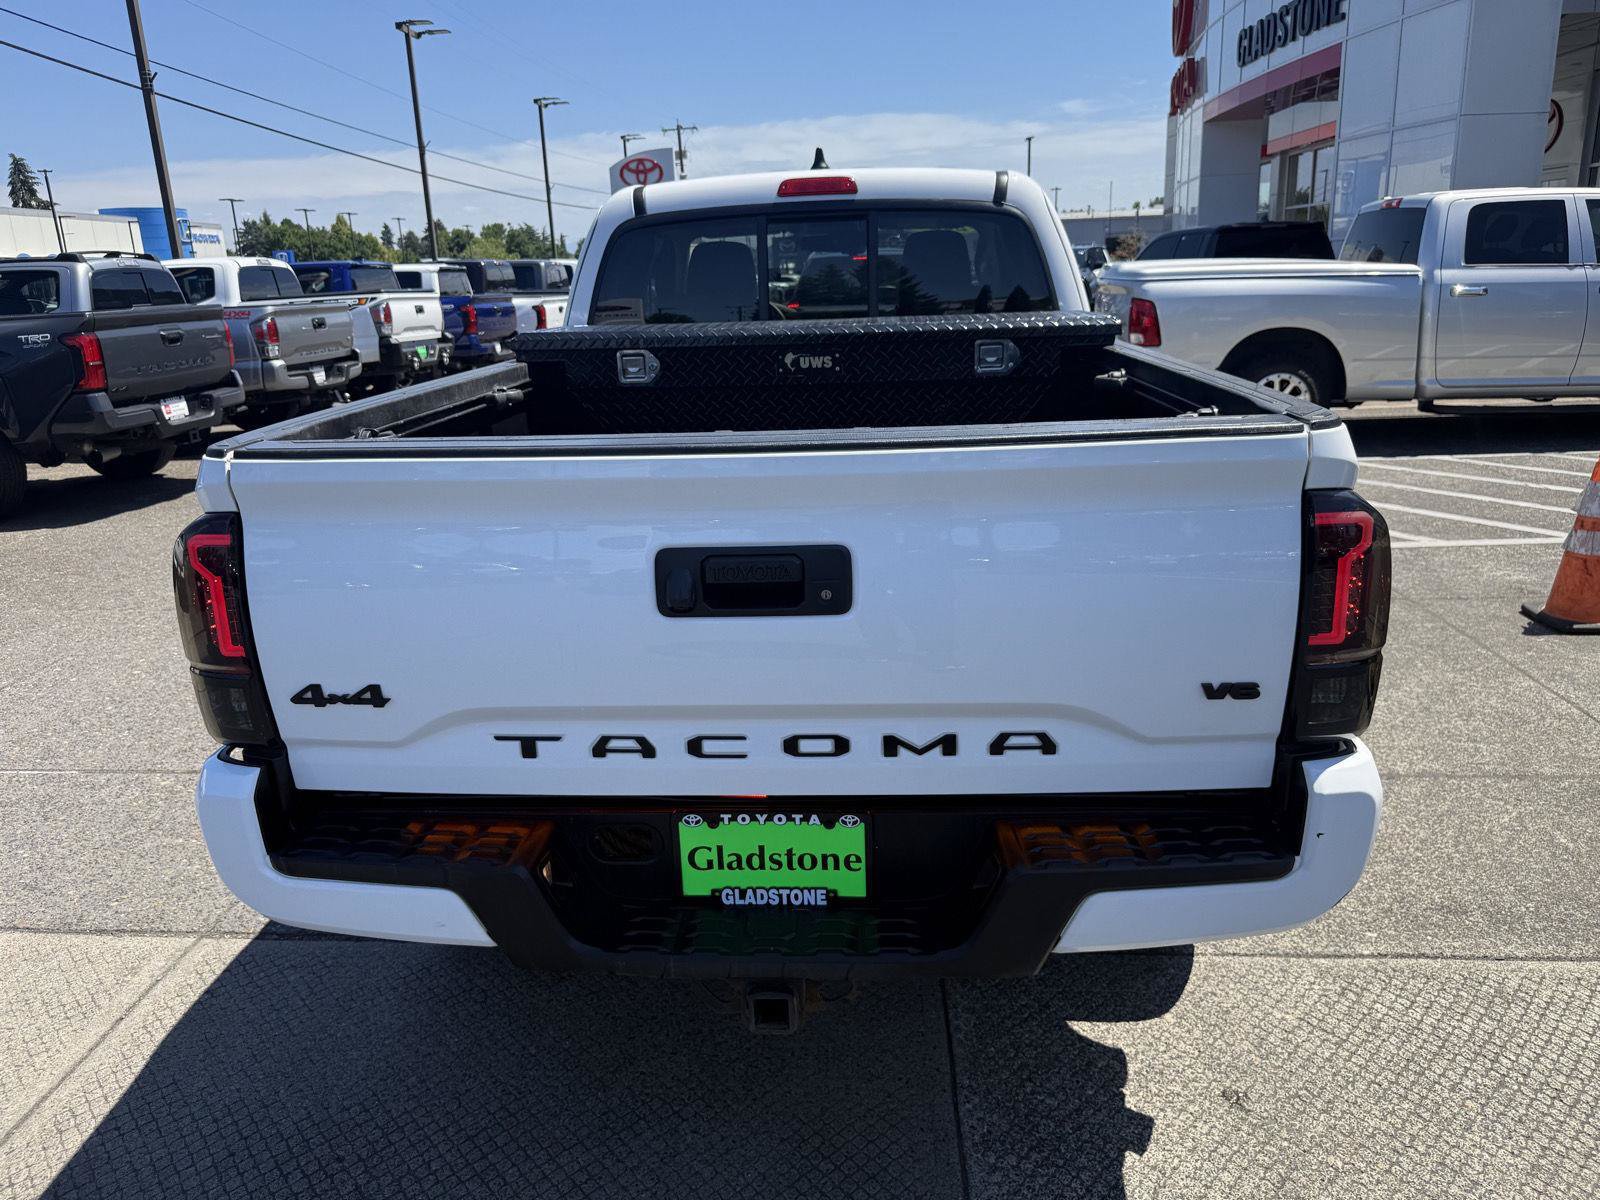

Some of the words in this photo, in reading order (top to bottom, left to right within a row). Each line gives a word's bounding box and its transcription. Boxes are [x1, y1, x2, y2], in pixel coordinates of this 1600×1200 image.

[1236, 0, 1347, 68] GLADSTONE
[18, 333, 50, 343] TRD
[800, 355, 833, 369] UWS
[707, 564, 793, 581] TOYOTA
[1201, 682, 1260, 700] V6
[493, 731, 1058, 759] TACOMA
[720, 813, 821, 826] TOYOTA
[687, 844, 863, 873] Gladstone
[721, 888, 828, 906] GLADSTONE
